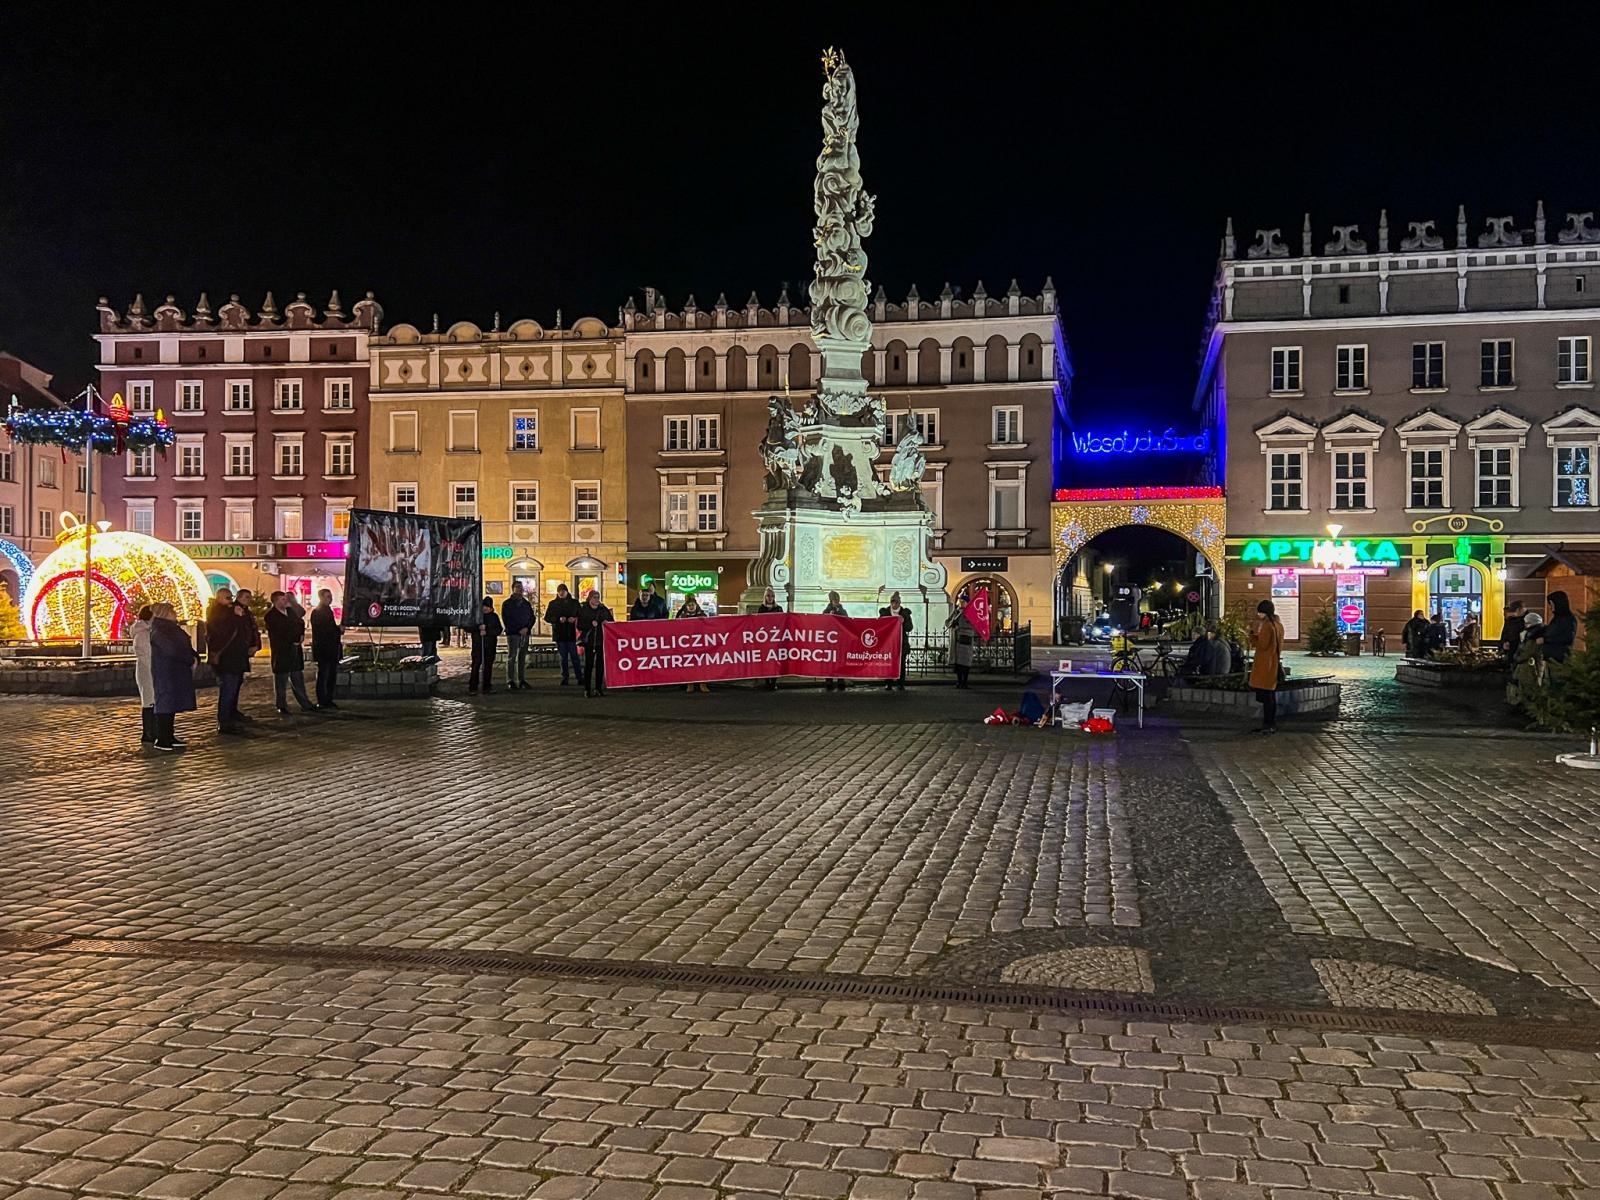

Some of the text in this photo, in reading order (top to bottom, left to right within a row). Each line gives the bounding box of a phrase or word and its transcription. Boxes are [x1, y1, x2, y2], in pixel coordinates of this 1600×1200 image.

[1242, 541, 1400, 561] APTKA
[671, 575, 712, 587] żabka
[617, 626, 839, 652] PUBLICZNY RÓŻANIEC
[618, 647, 837, 671] O ZATRZYMANIE ABORCJI
[846, 651, 892, 661] RatujŻycie.pl
